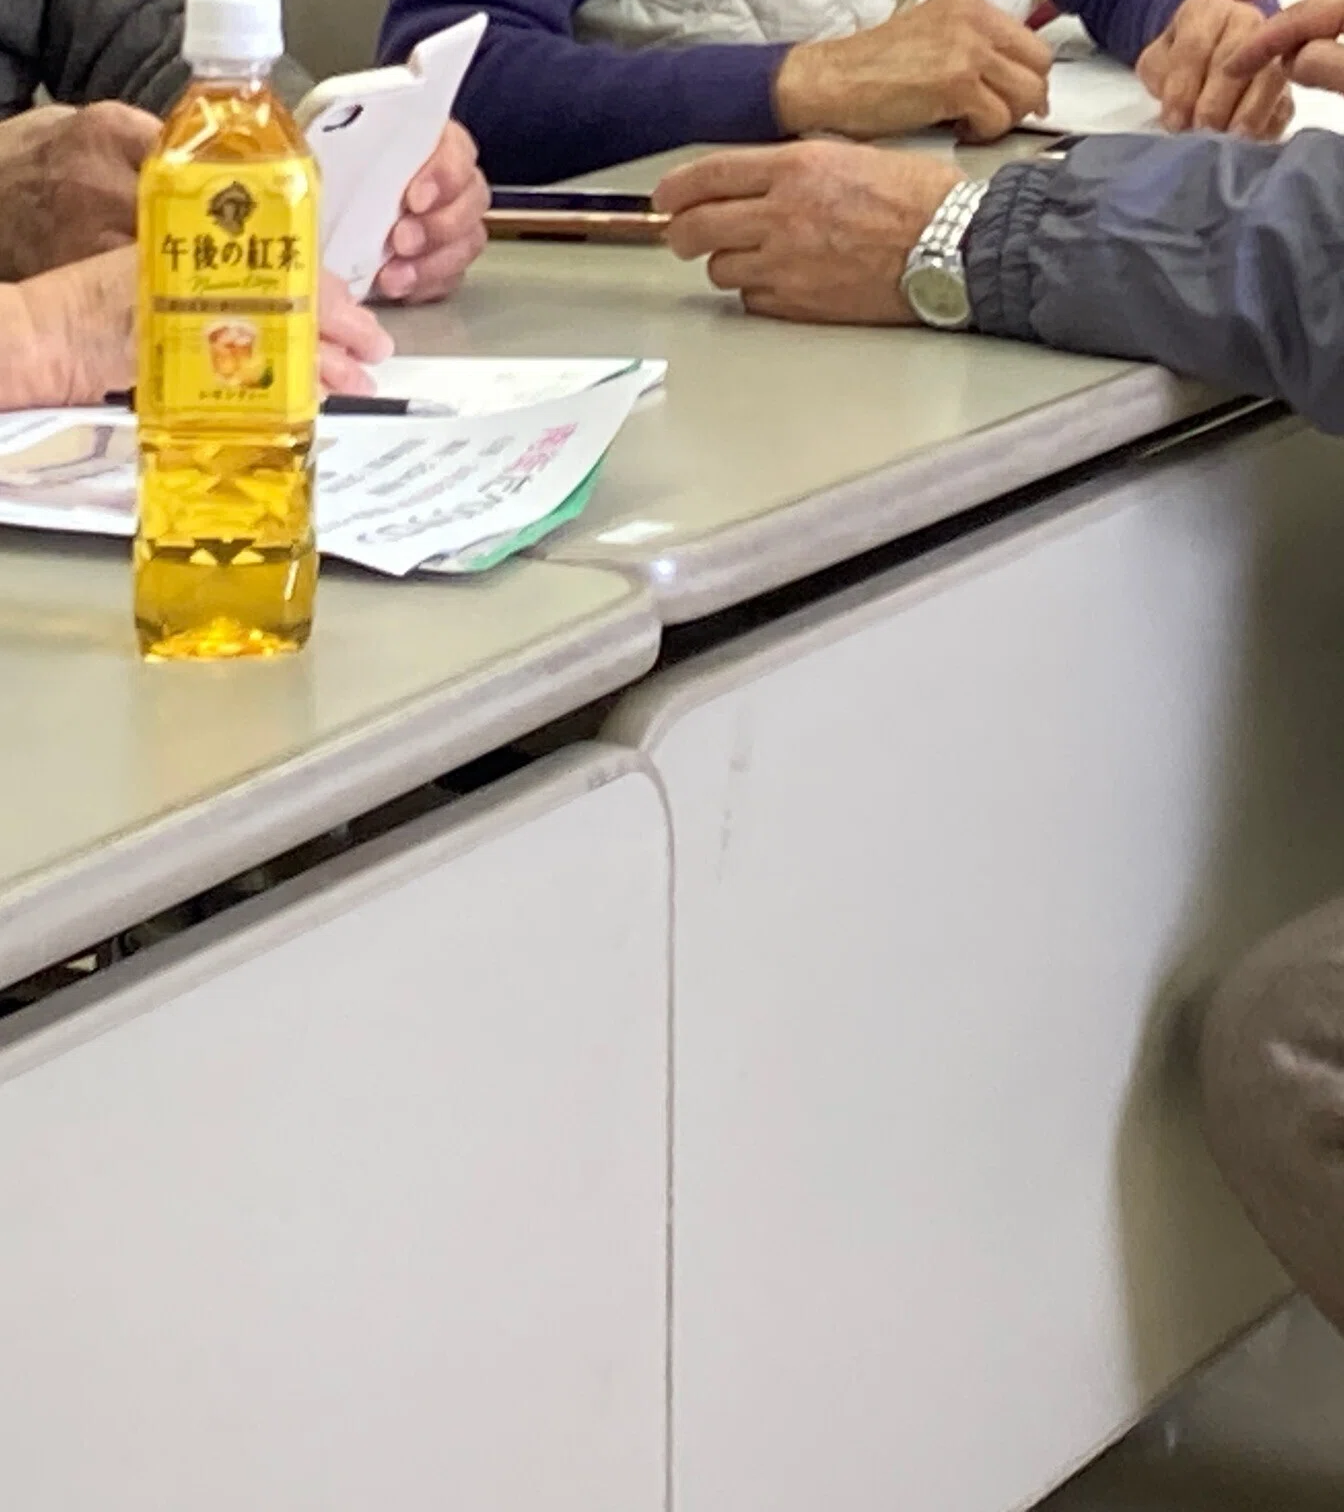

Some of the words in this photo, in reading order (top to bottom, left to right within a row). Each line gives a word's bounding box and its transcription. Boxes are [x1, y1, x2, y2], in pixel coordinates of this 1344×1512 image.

[161, 234, 300, 272] 午後の紅茶
